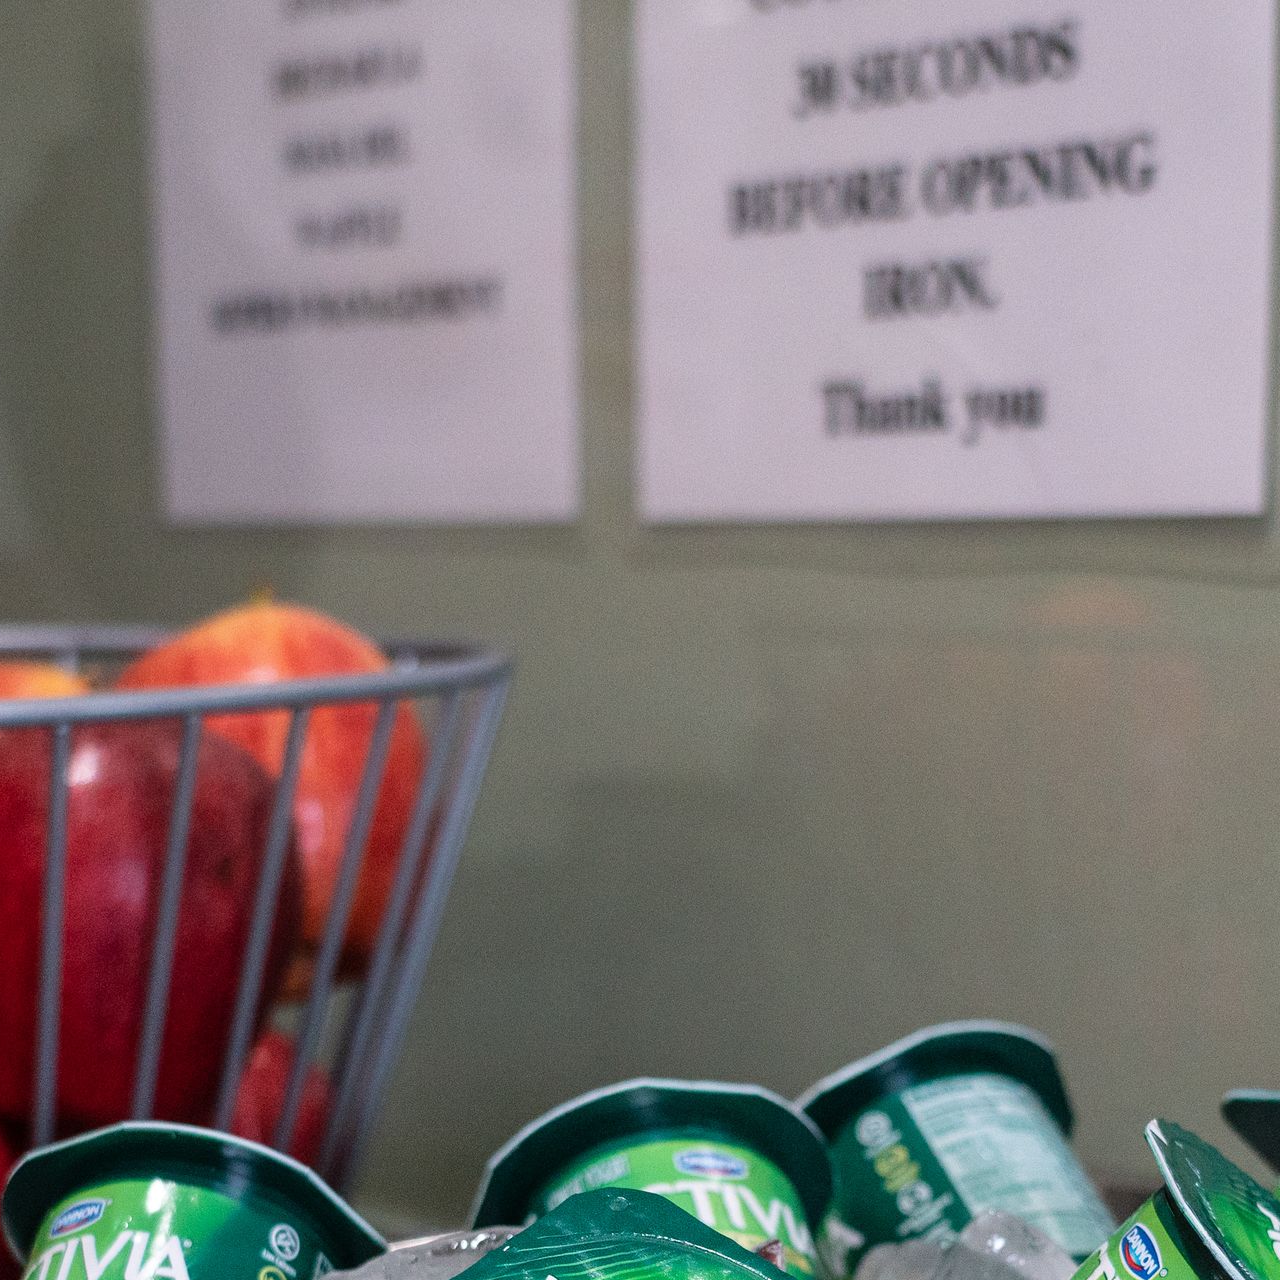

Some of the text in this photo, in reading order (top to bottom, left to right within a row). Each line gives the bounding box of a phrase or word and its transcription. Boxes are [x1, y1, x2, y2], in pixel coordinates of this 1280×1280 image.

[848, 18, 1081, 112] SECONDS
[728, 130, 1155, 236] BEFORE OPENING
[823, 373, 1046, 448] Thank you
[1125, 1227, 1158, 1276] DANNON
